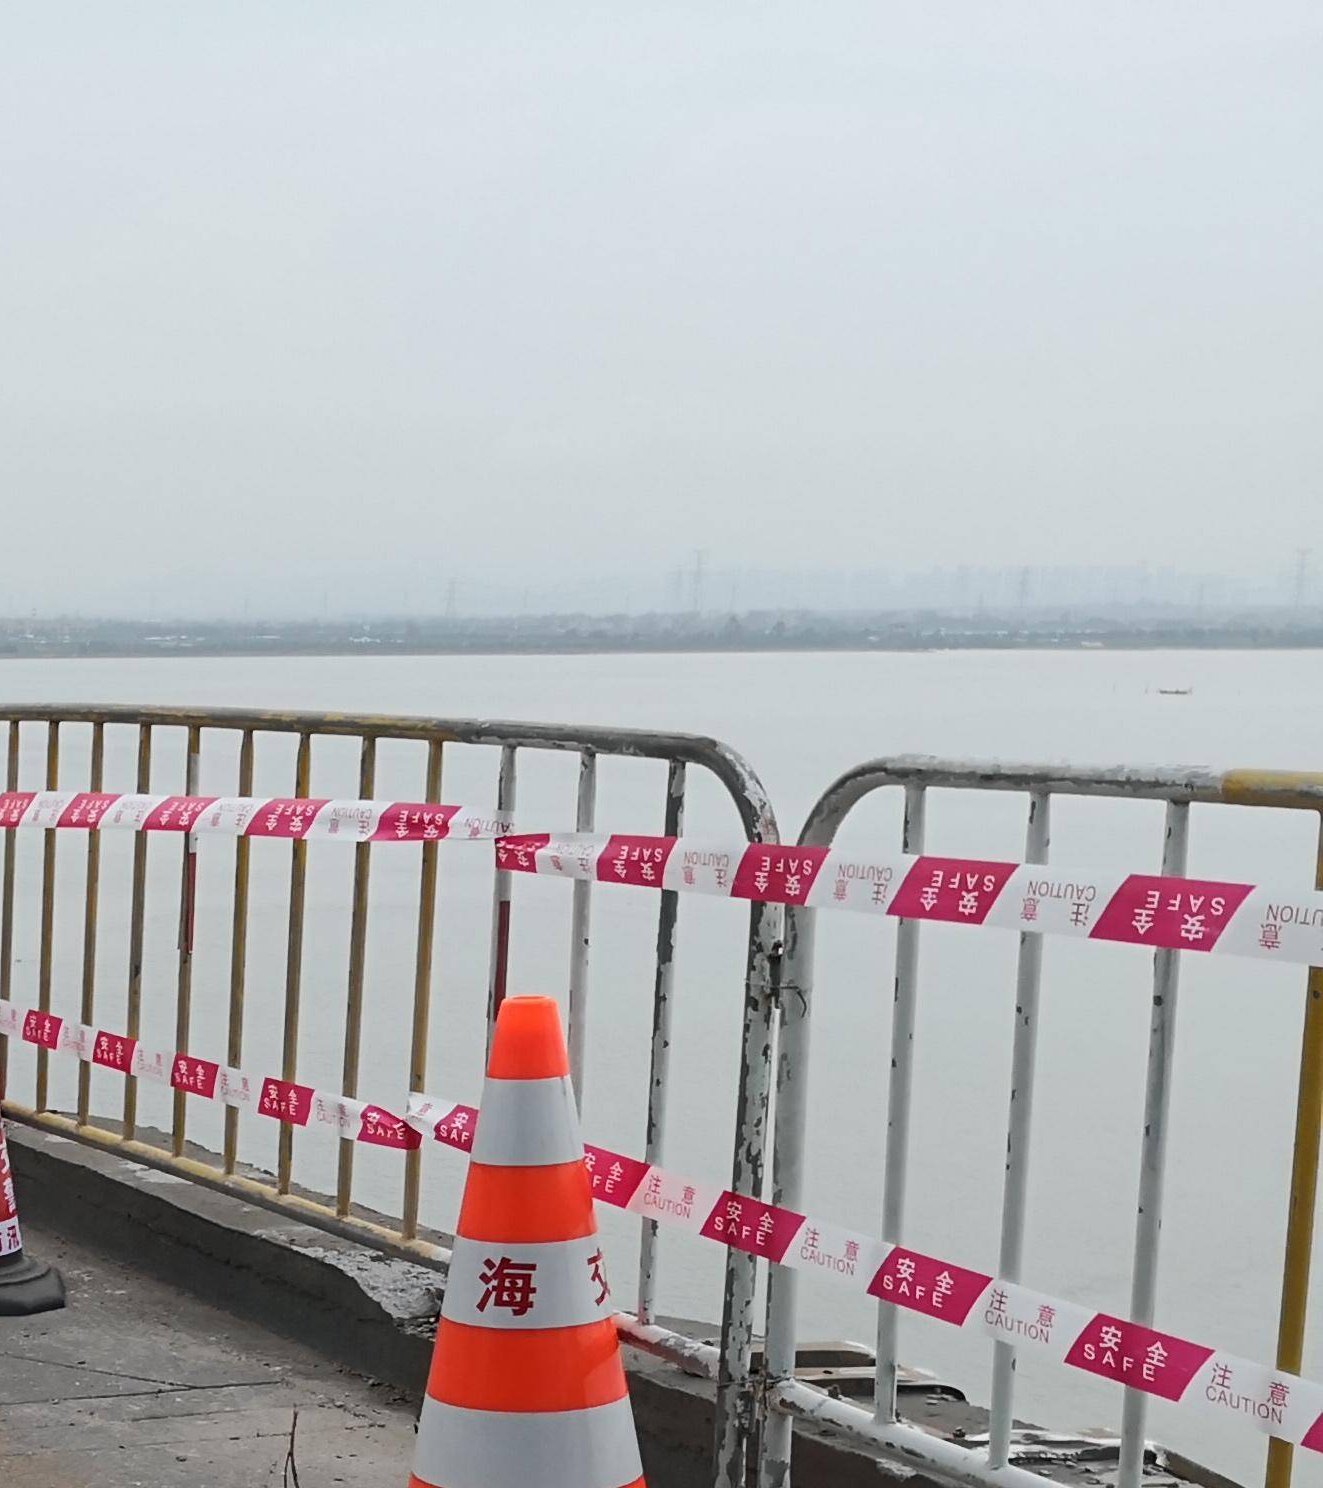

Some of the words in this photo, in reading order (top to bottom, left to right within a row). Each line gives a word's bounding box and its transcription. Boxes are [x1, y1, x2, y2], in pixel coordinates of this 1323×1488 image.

[275, 804, 315, 816] SAFE
[399, 810, 444, 824] SAFE
[618, 845, 663, 862] SAFE
[761, 856, 813, 876] SAFE
[755, 871, 801, 896] 安全
[838, 863, 893, 881] CAUTION
[931, 870, 996, 892] SAFE
[833, 878, 888, 905] 注意
[920, 886, 979, 916] 安全
[1027, 880, 1097, 902] CAUTION
[1145, 890, 1226, 916] SAFE
[1020, 898, 1090, 927] 注意
[1131, 907, 1208, 941] 安全
[1266, 903, 1323, 927] UTION
[1259, 923, 1282, 950] 意
[263, 1097, 297, 1116] SAFE
[267, 1084, 300, 1106] 安全
[440, 1124, 471, 1143] SAF
[592, 1174, 615, 1194] FE
[648, 1174, 696, 1205] 注意
[643, 1192, 692, 1219] CAUTION
[725, 1200, 775, 1234] 安全
[713, 1216, 766, 1247] SAFE
[804, 1226, 860, 1262] 注意
[799, 1246, 856, 1276] CAUTION
[895, 1257, 955, 1296] 安全
[882, 1274, 944, 1309] SAFE
[989, 1287, 1056, 1329] 注意
[984, 1310, 1050, 1344] CAUTION
[1099, 1325, 1169, 1368] 安全
[1083, 1343, 1156, 1382] SAFE
[1210, 1362, 1291, 1409] 注意
[1205, 1385, 1284, 1425] CAUTION
